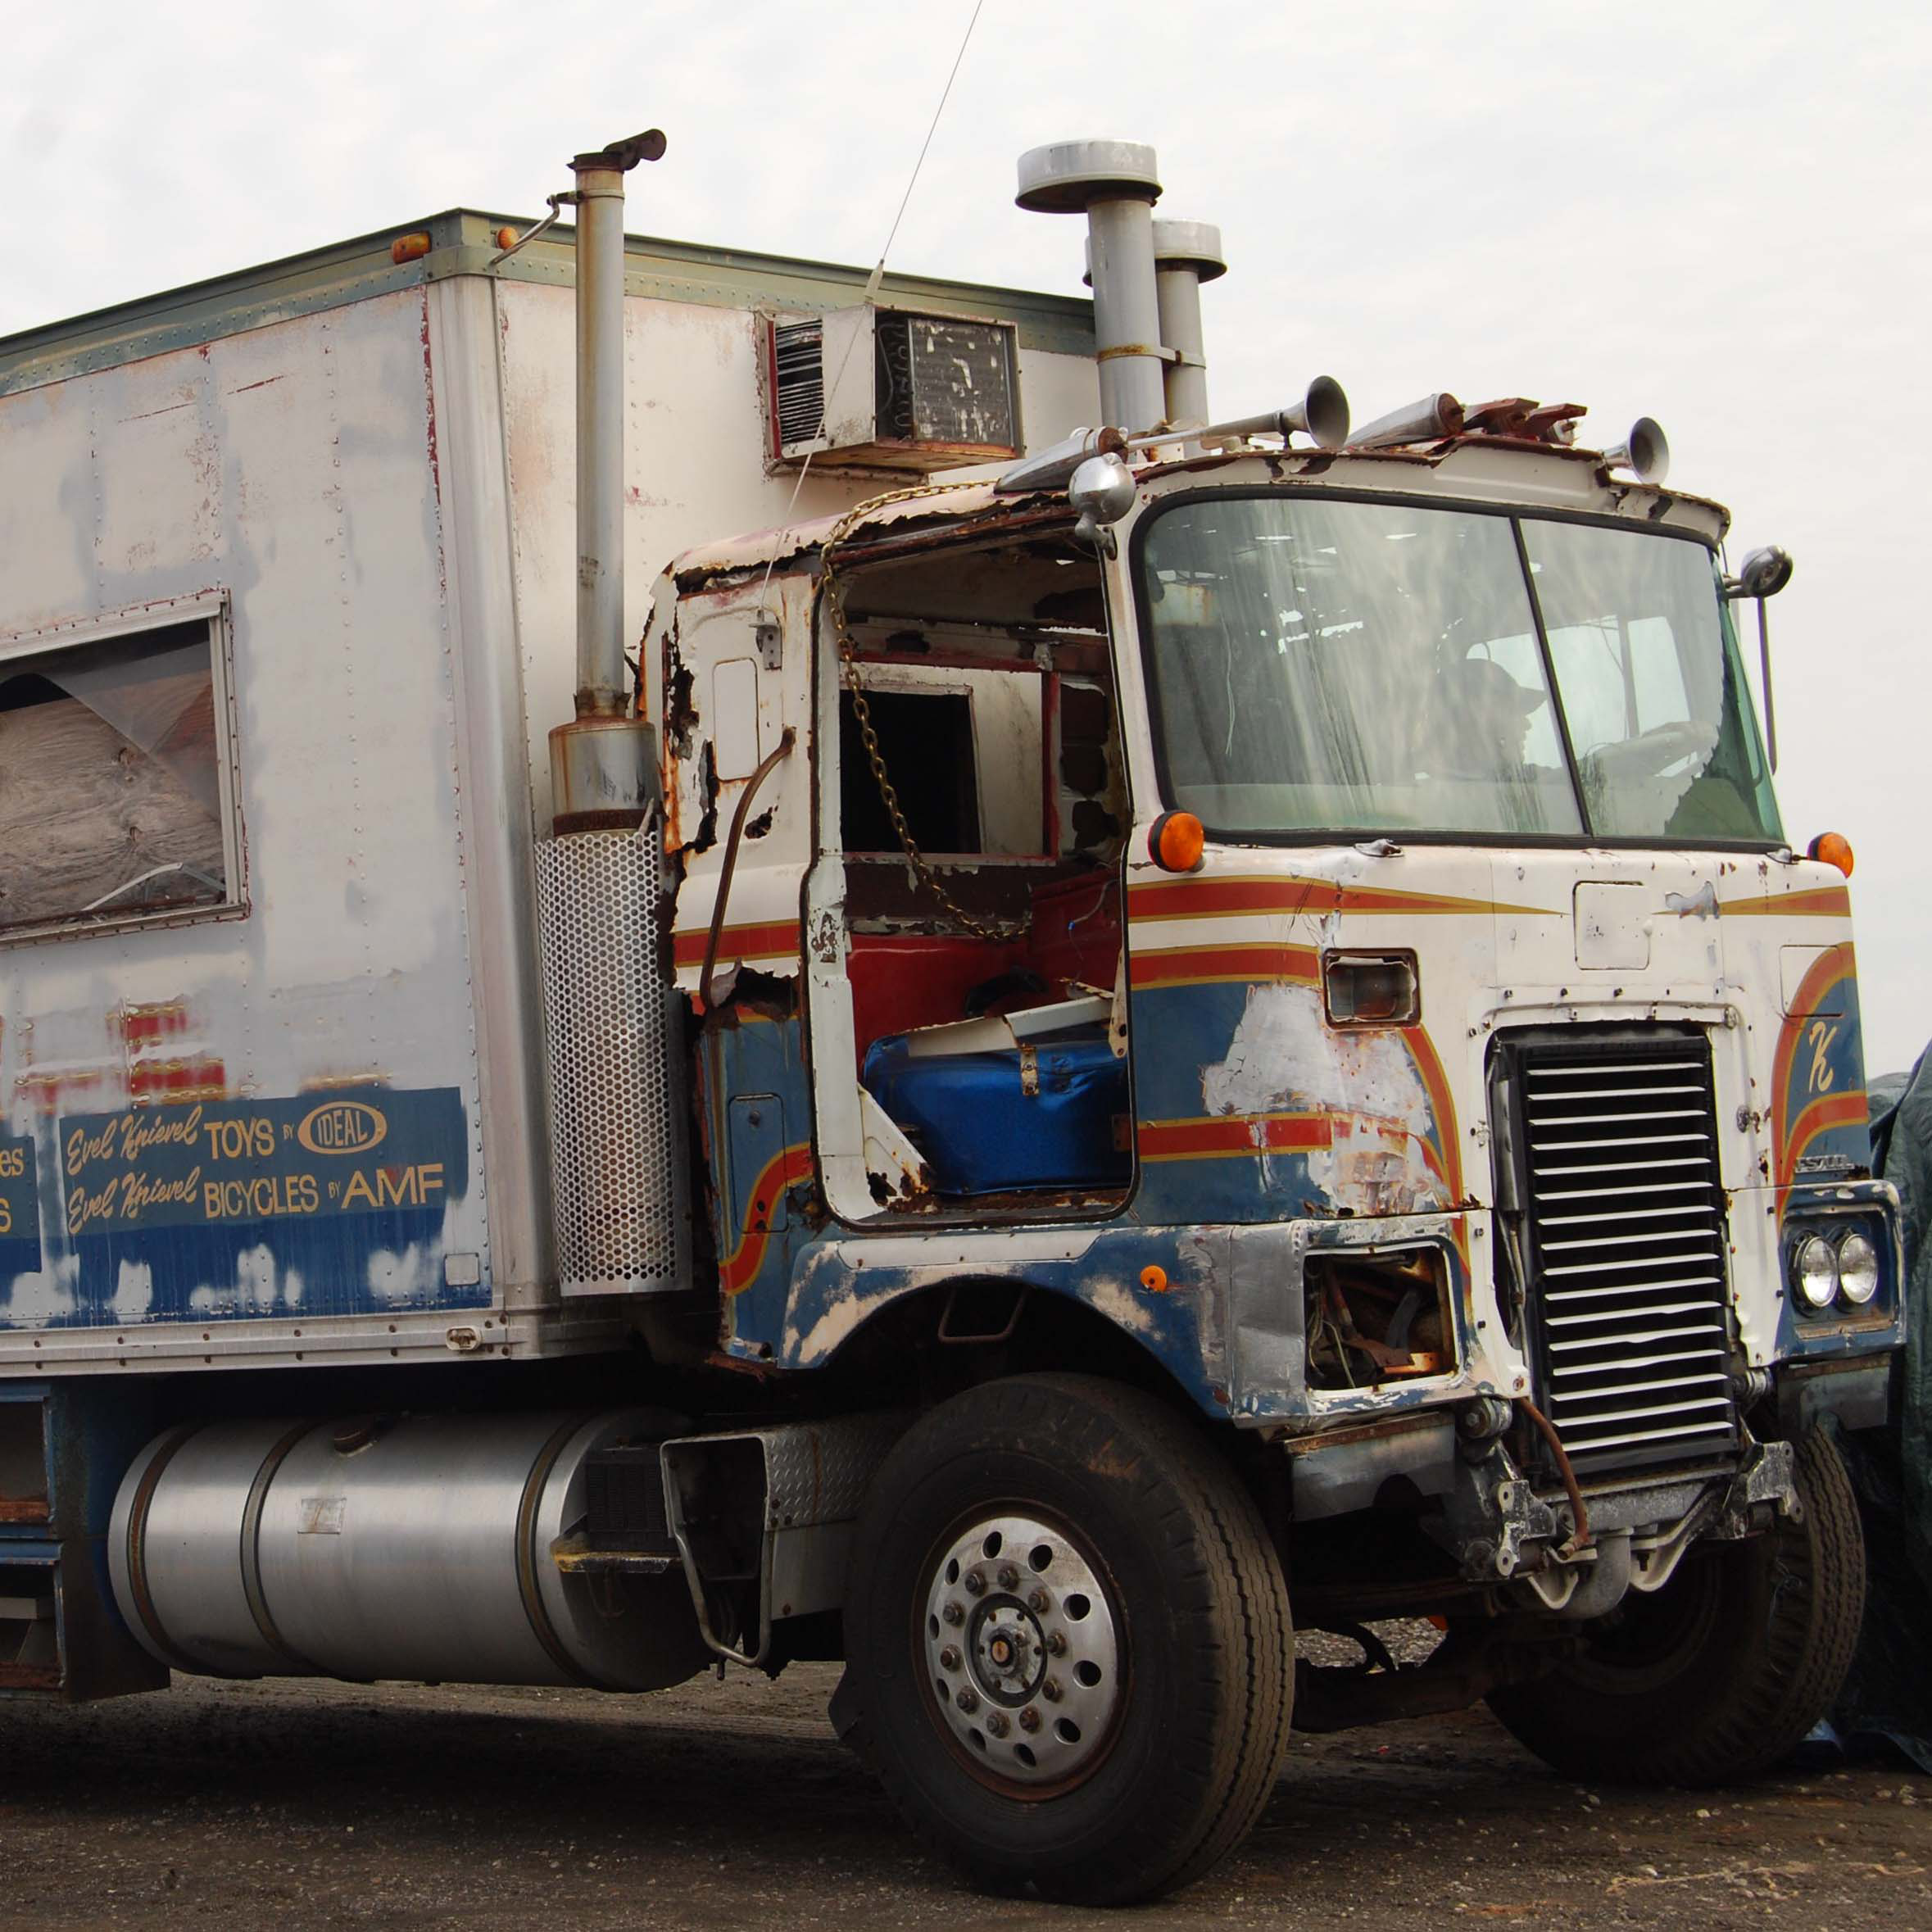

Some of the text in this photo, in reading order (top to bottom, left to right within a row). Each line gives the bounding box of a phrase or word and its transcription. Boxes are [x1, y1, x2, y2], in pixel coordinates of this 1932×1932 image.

[67, 1105, 368, 1176] Evel Knievel TOYS BY IDEAL
[68, 1163, 443, 1234] Evel Knievel BICYCLES BY AMF
